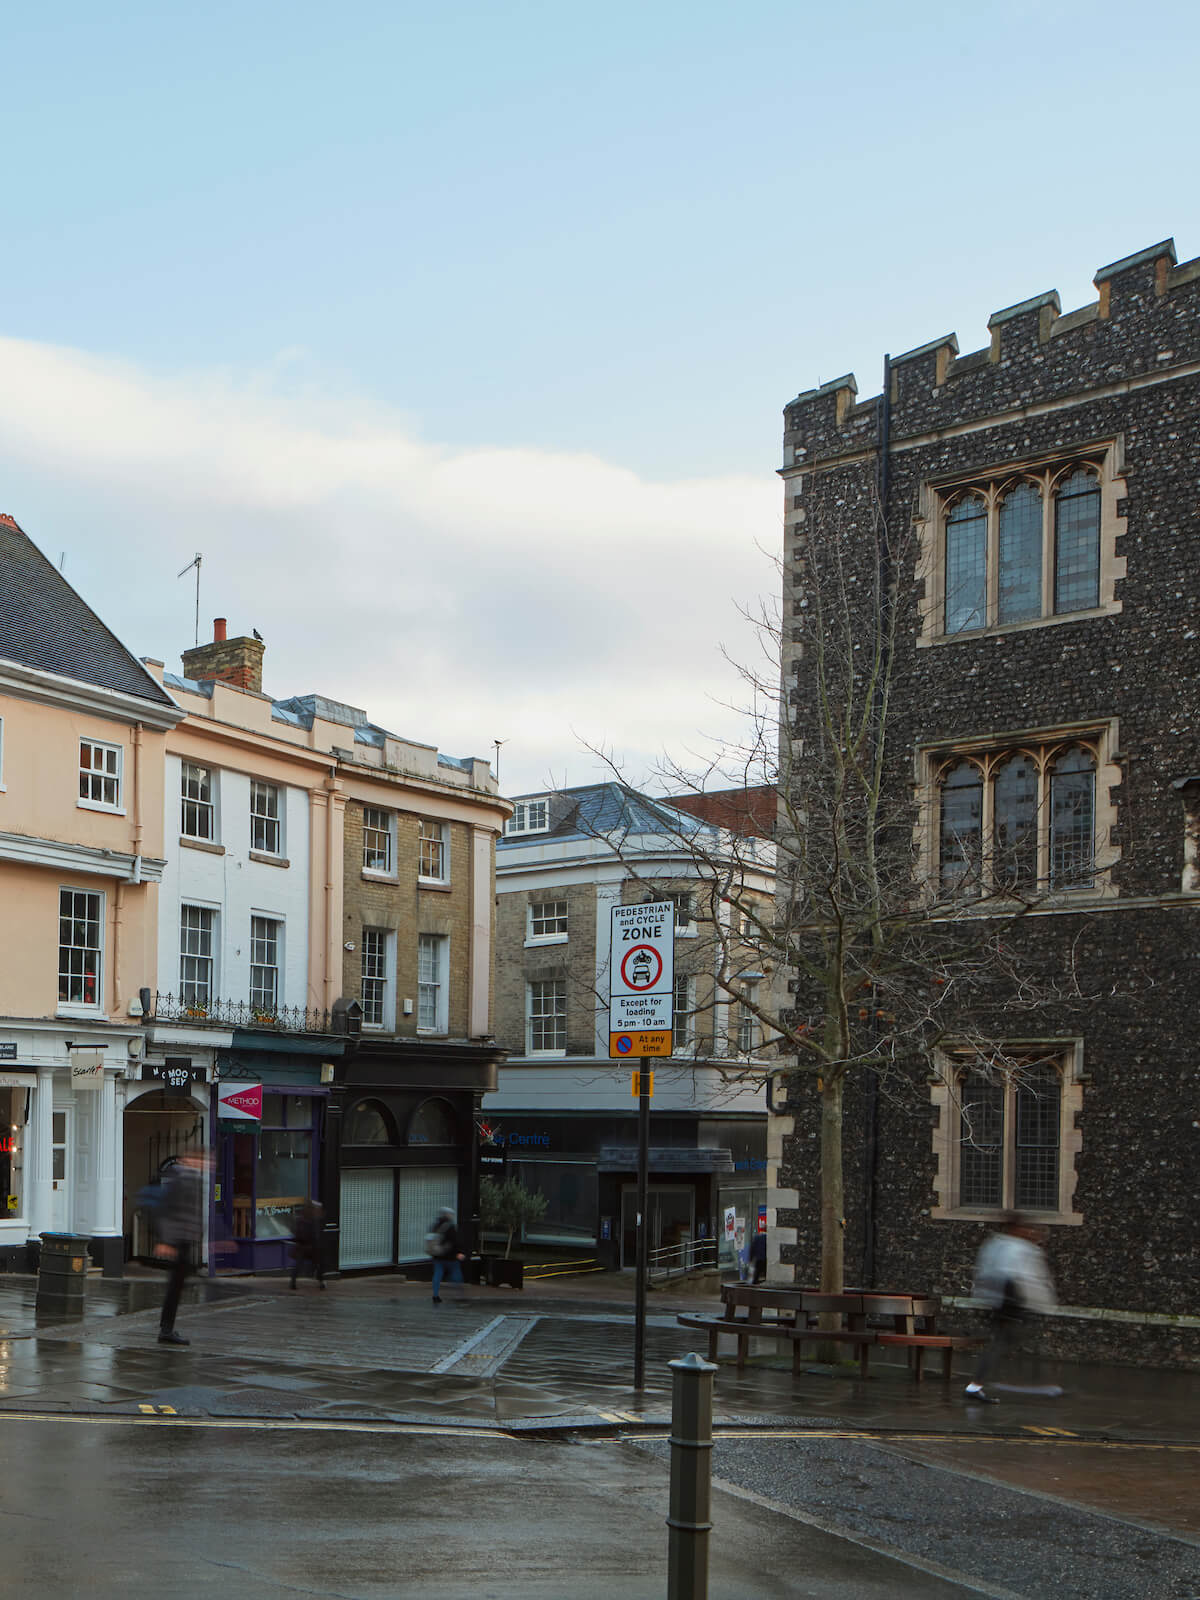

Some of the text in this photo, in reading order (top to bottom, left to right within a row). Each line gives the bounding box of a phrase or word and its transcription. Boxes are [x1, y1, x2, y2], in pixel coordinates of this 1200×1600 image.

[615, 904, 671, 917] PEDESTRIAN
[620, 914, 665, 926] and CYCLE
[622, 926, 662, 941] ZONE
[620, 999, 662, 1008] Except for
[626, 1007, 656, 1017] loading
[639, 1034, 665, 1044] At any
[642, 1044, 661, 1053] time
